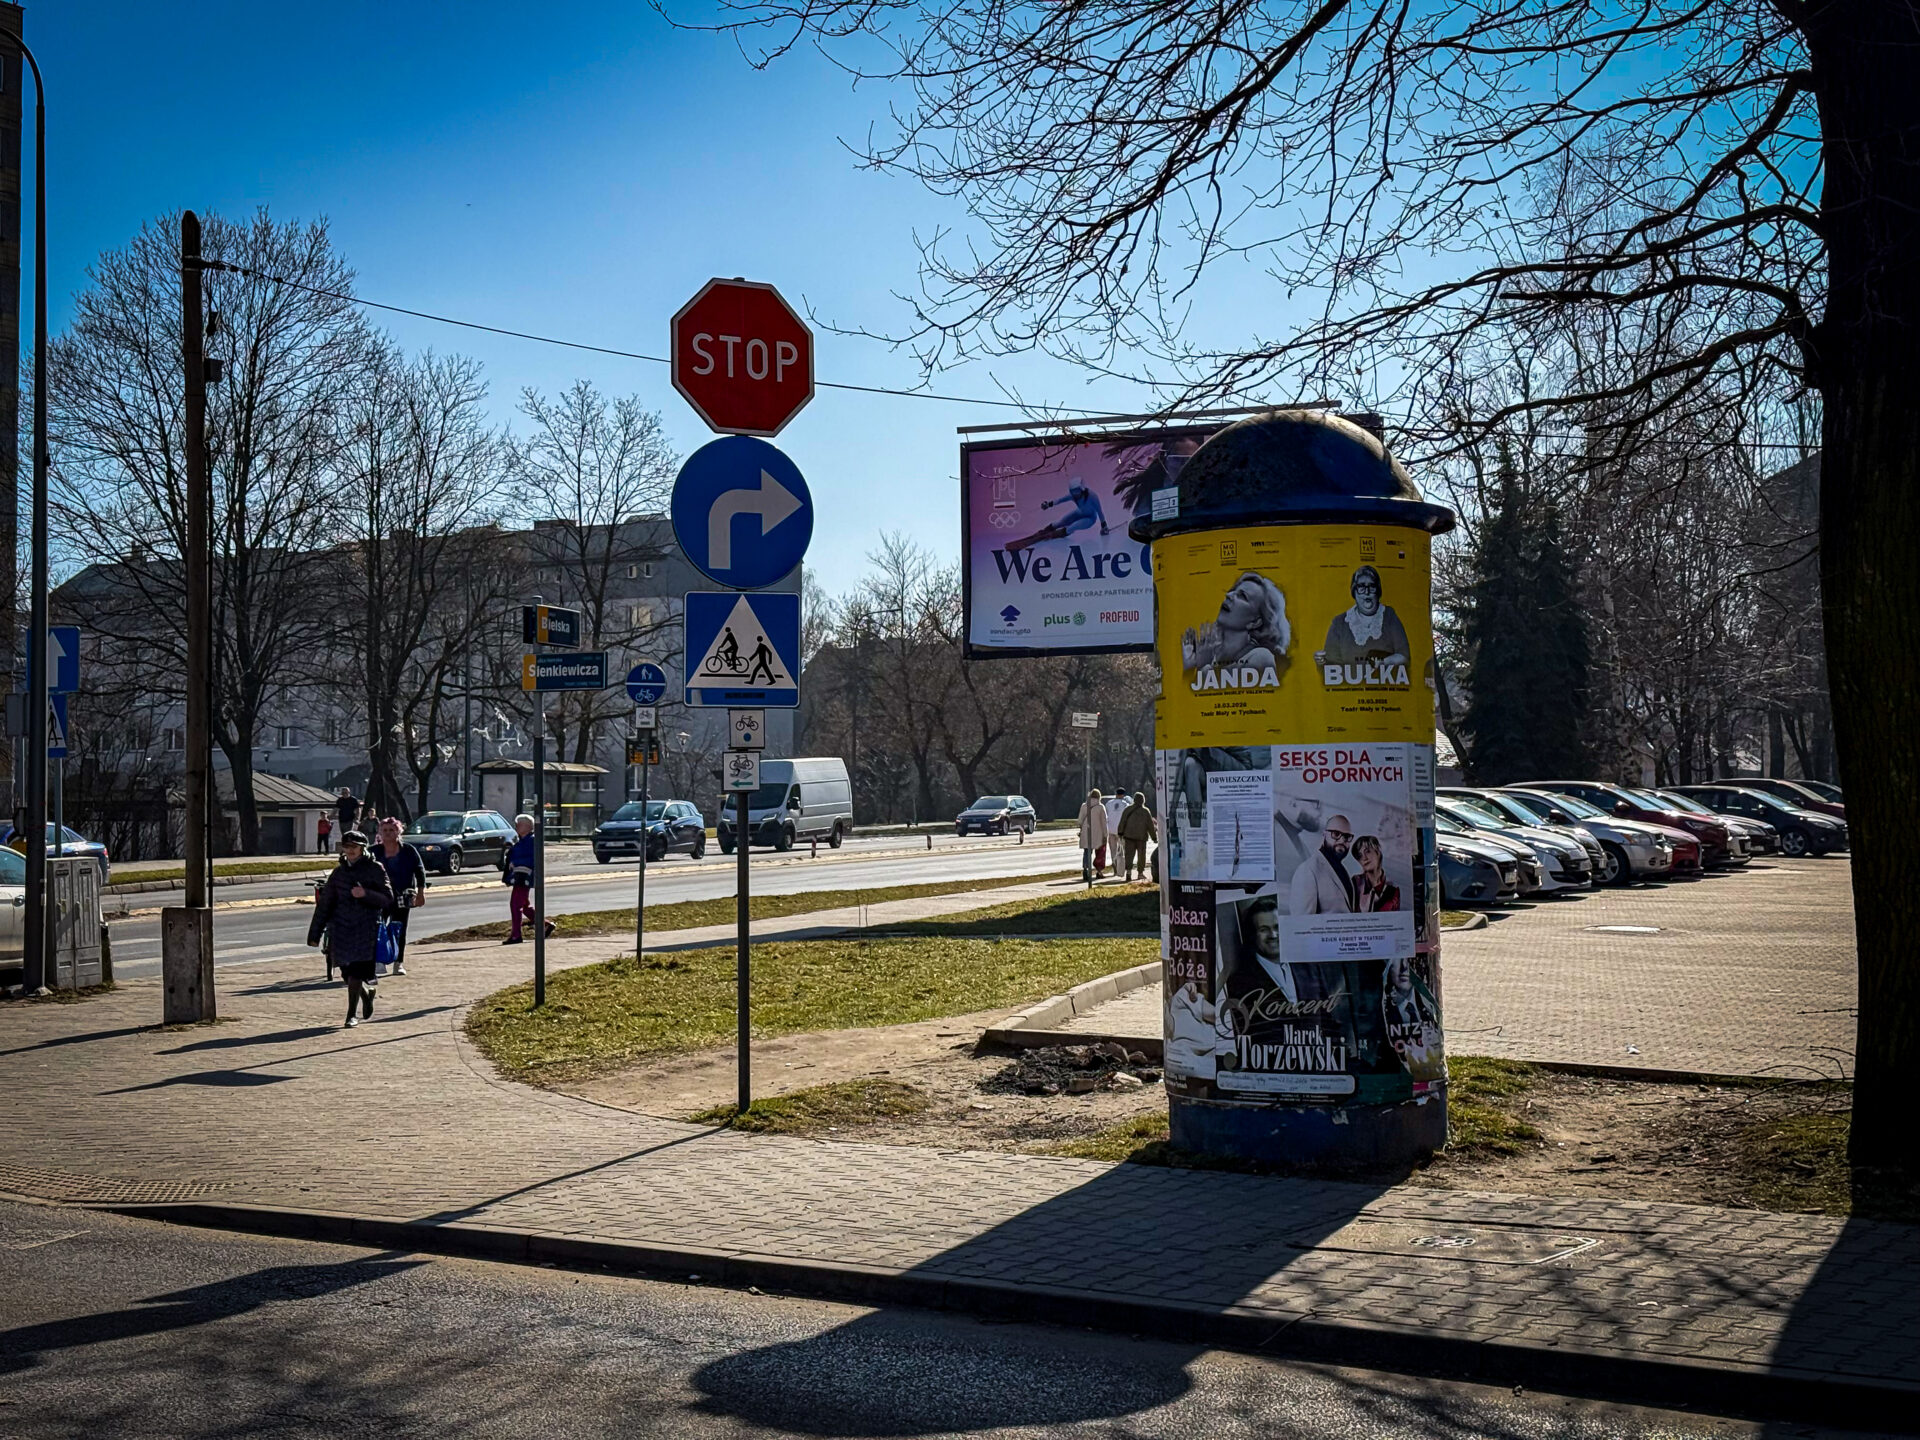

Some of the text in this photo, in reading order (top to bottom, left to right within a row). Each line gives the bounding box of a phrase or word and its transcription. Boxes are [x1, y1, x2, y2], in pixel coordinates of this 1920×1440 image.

[692, 332, 799, 382] STOP
[991, 547, 1052, 584] We
[1060, 545, 1132, 581] Are
[1104, 588, 1143, 598] PARTNERZY
[541, 616, 570, 633] Bielska
[1044, 613, 1071, 627] plus
[1100, 610, 1139, 623] PROFBUD
[528, 663, 600, 678] Sienkiewicza
[1190, 667, 1281, 691] JANDA
[1323, 664, 1410, 685] BUŁKA
[1280, 750, 1371, 768] SEKS DLA
[1209, 776, 1270, 784] OBWIESZCZENIE
[1303, 767, 1403, 783] OPORNYCH
[1168, 905, 1208, 926] Oskar
[1173, 933, 1208, 954] pani
[1168, 956, 1207, 979] Róża
[1238, 987, 1353, 1021] Koncert
[1283, 1024, 1324, 1045] Marek
[1237, 1034, 1346, 1072] Torzewski
